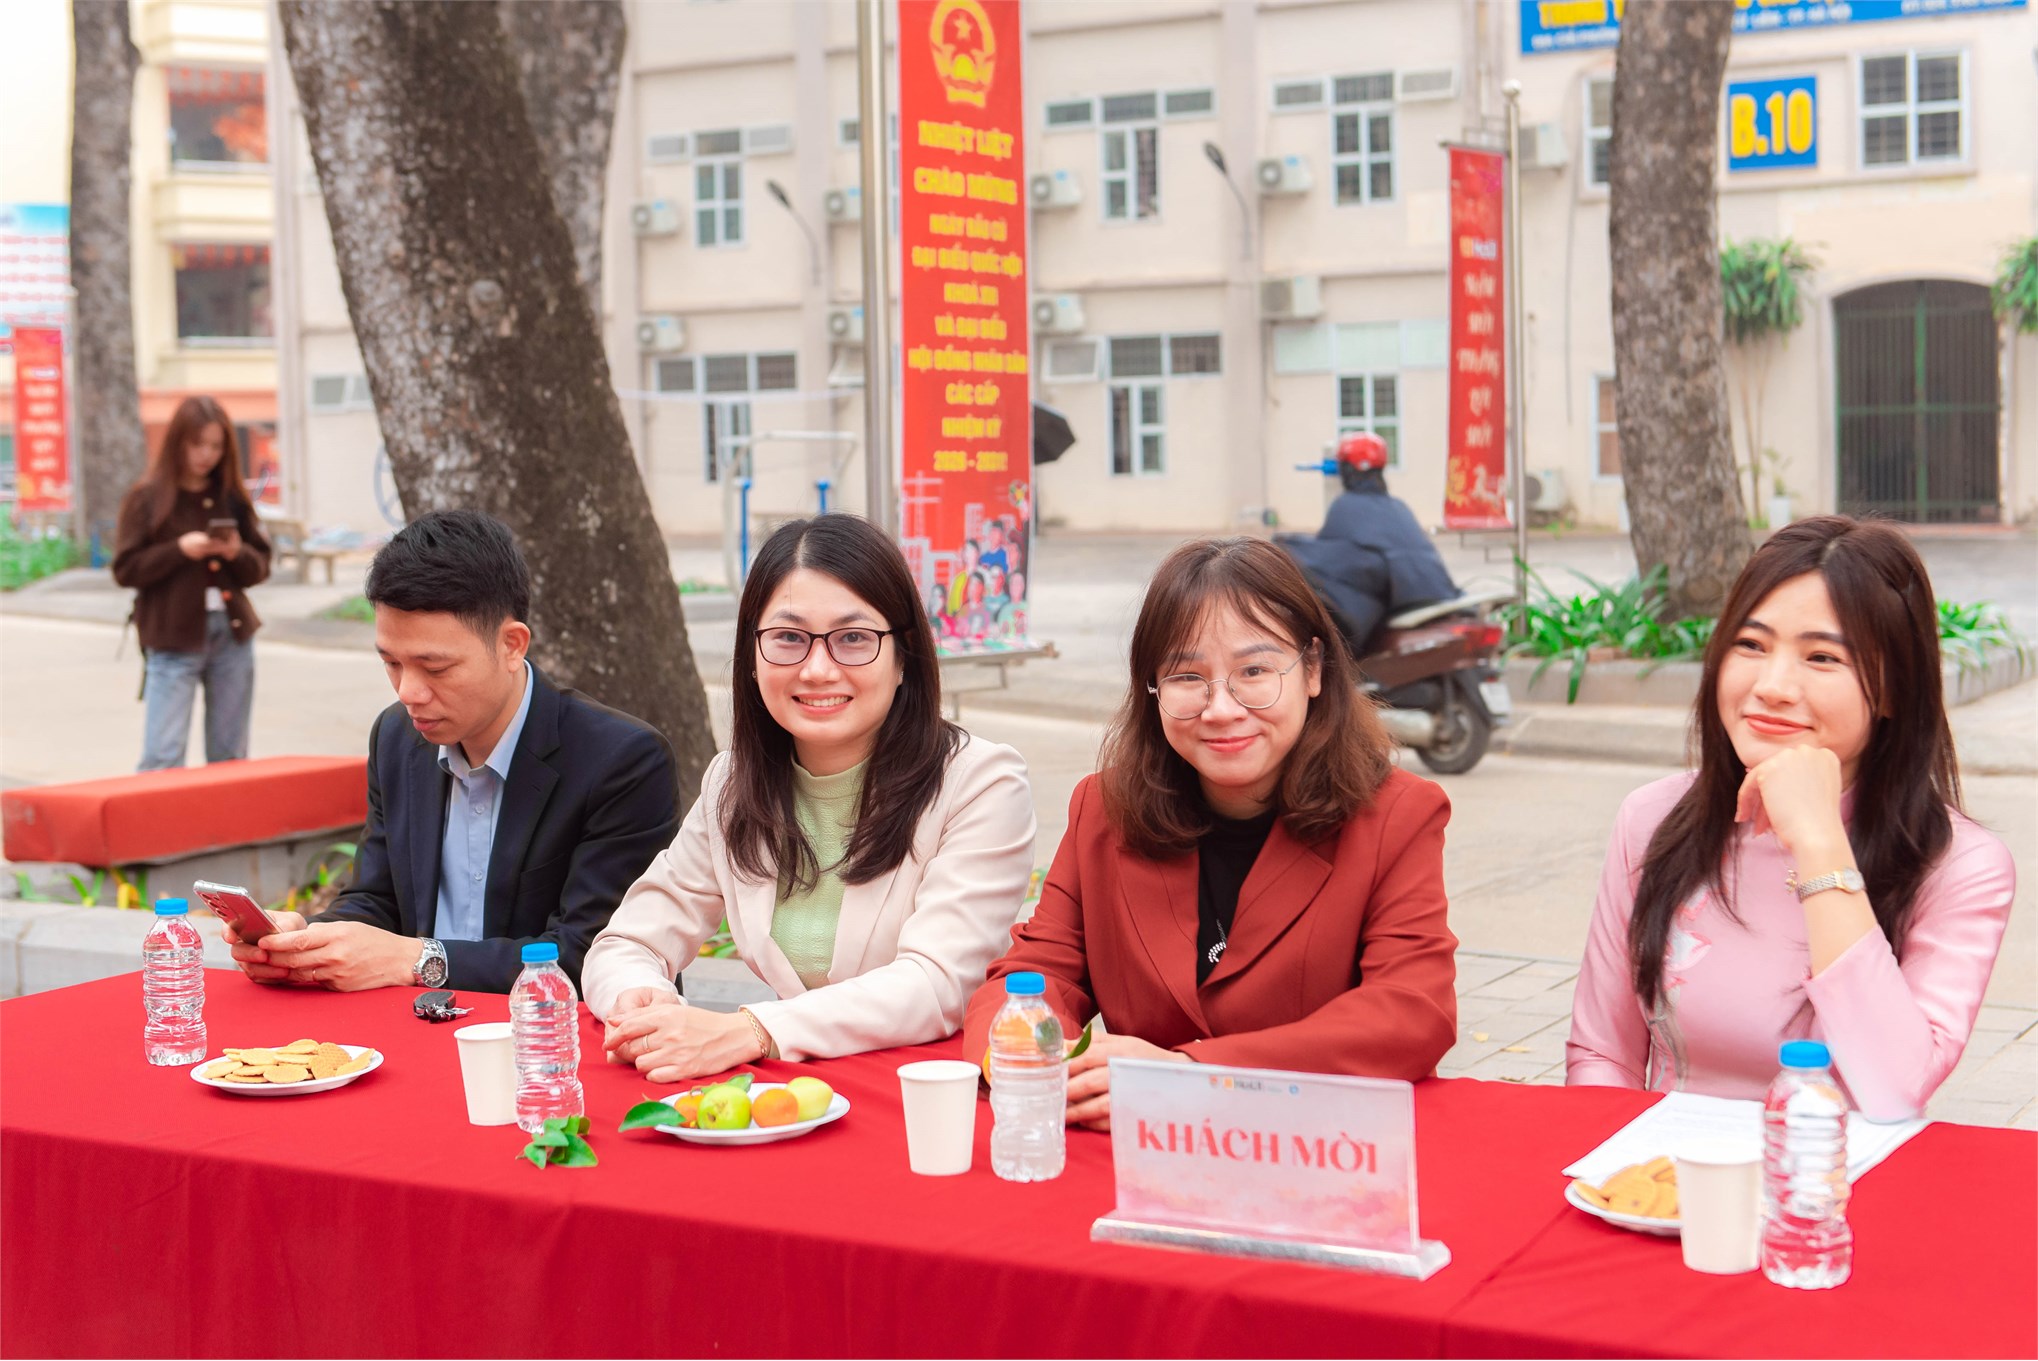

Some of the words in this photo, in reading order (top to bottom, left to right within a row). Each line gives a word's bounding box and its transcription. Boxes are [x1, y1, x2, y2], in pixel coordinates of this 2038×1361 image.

[918, 119, 975, 155] NHIỆT
[976, 127, 1014, 161] LIỆT
[1730, 88, 1815, 158] B.10
[914, 165, 965, 198] CHÀO
[945, 379, 974, 405] CÁC
[974, 379, 1000, 405] CẤP
[1137, 1117, 1280, 1164] KHÁCH
[1292, 1131, 1377, 1174] MỜI
